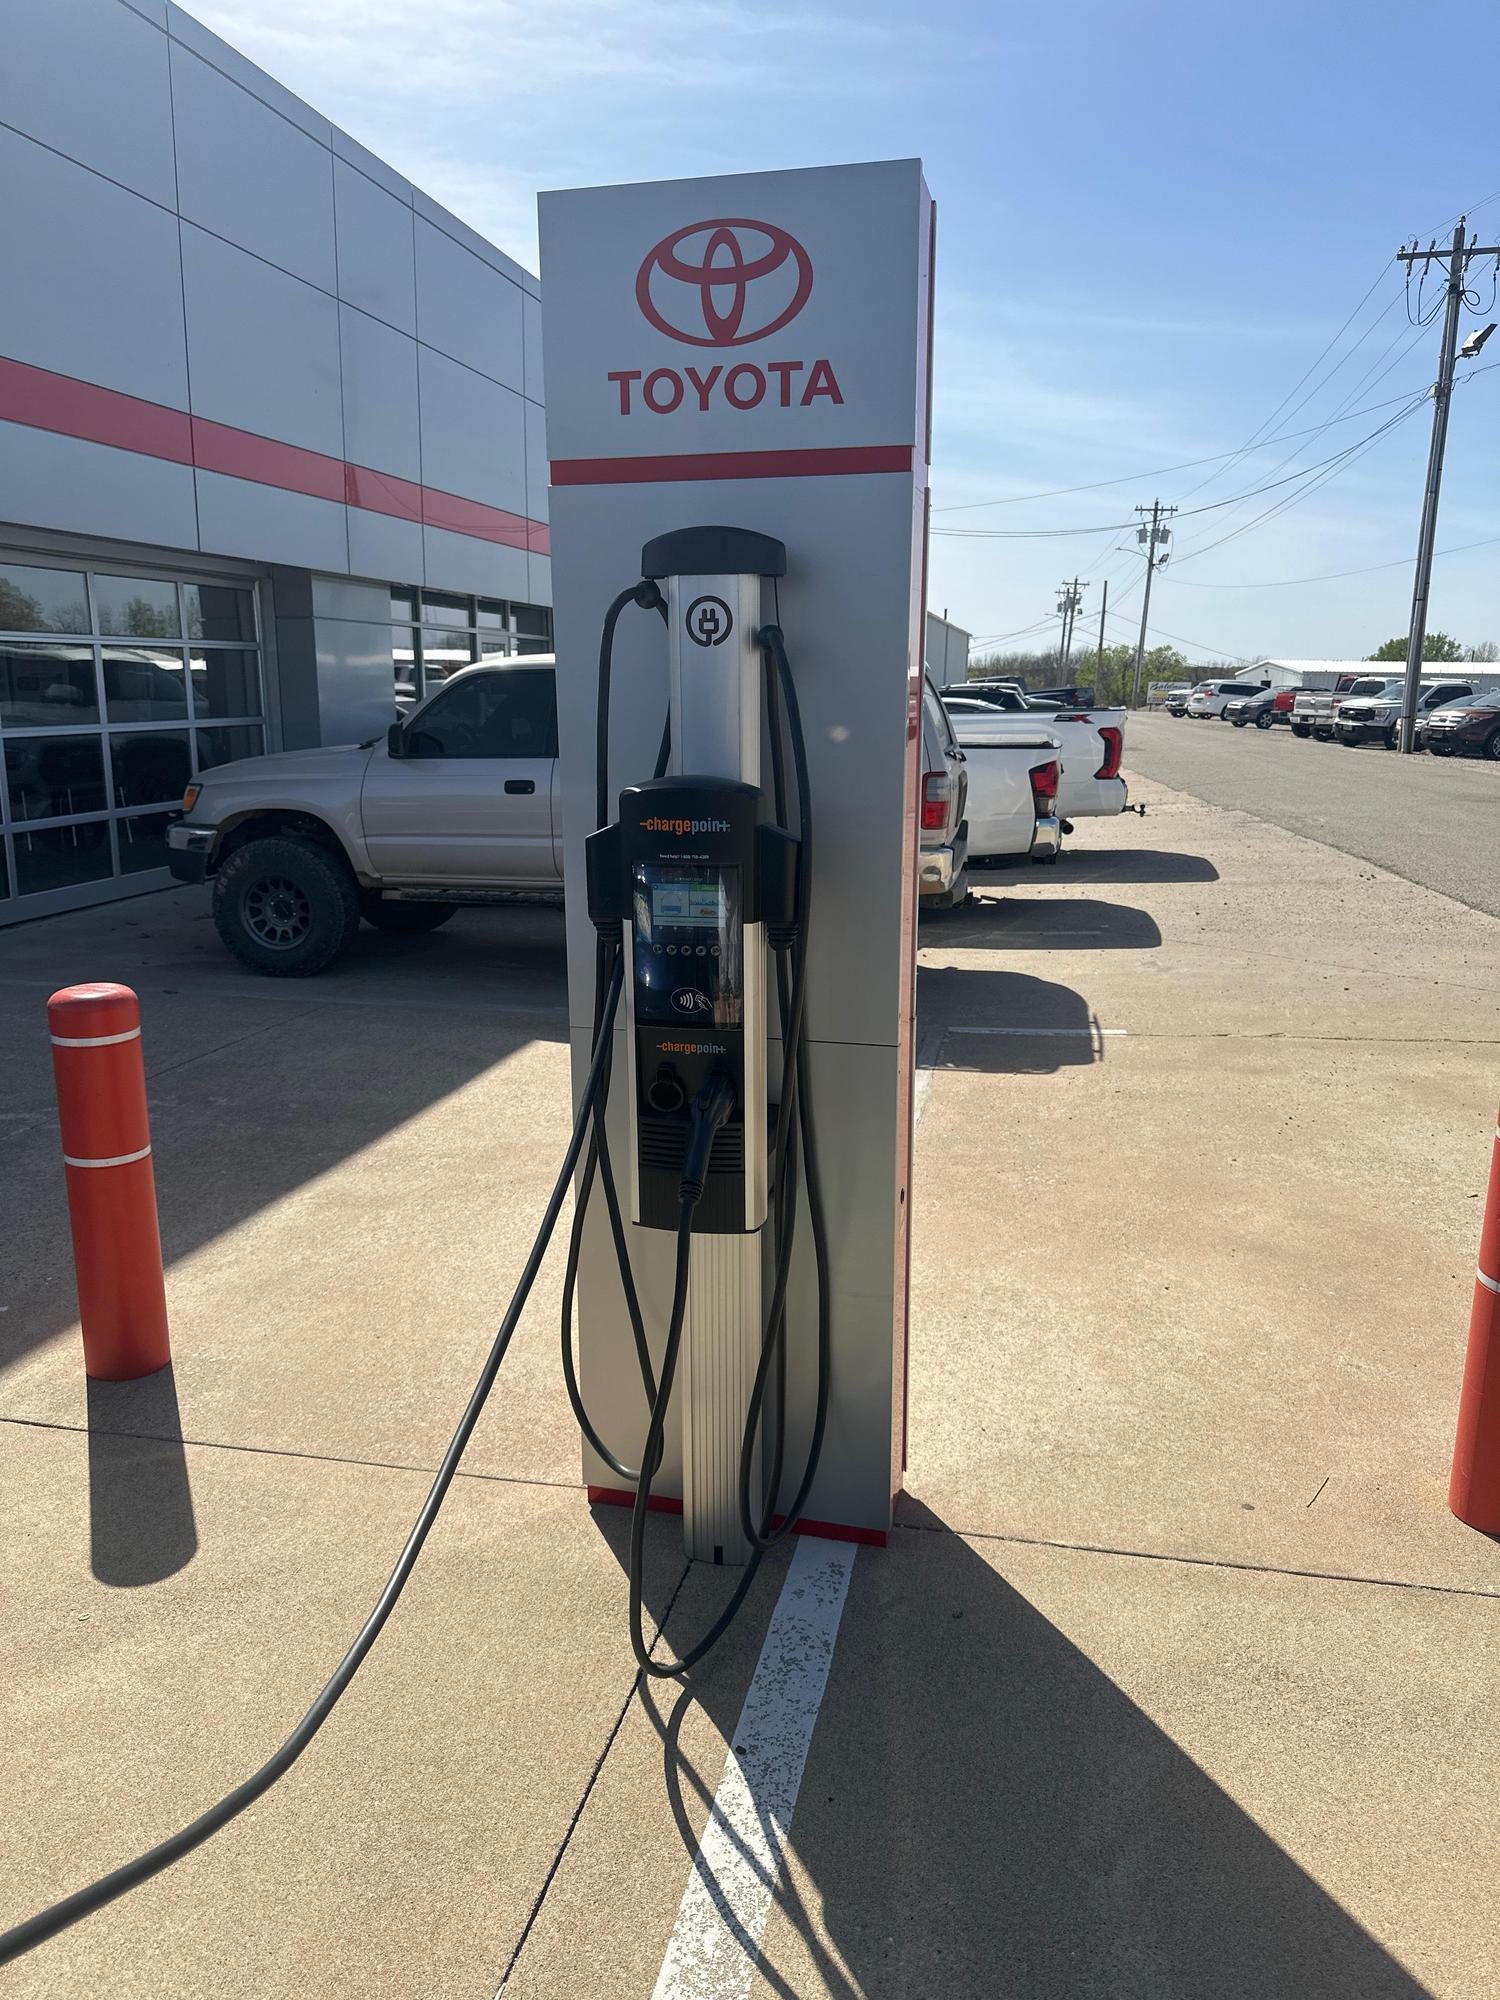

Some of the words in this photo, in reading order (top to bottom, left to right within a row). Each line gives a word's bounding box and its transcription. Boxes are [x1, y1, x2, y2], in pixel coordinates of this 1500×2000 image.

[608, 360, 845, 415] TOYOTA
[640, 817, 731, 834] chargepoint
[656, 1041, 727, 1055] chargepoint
